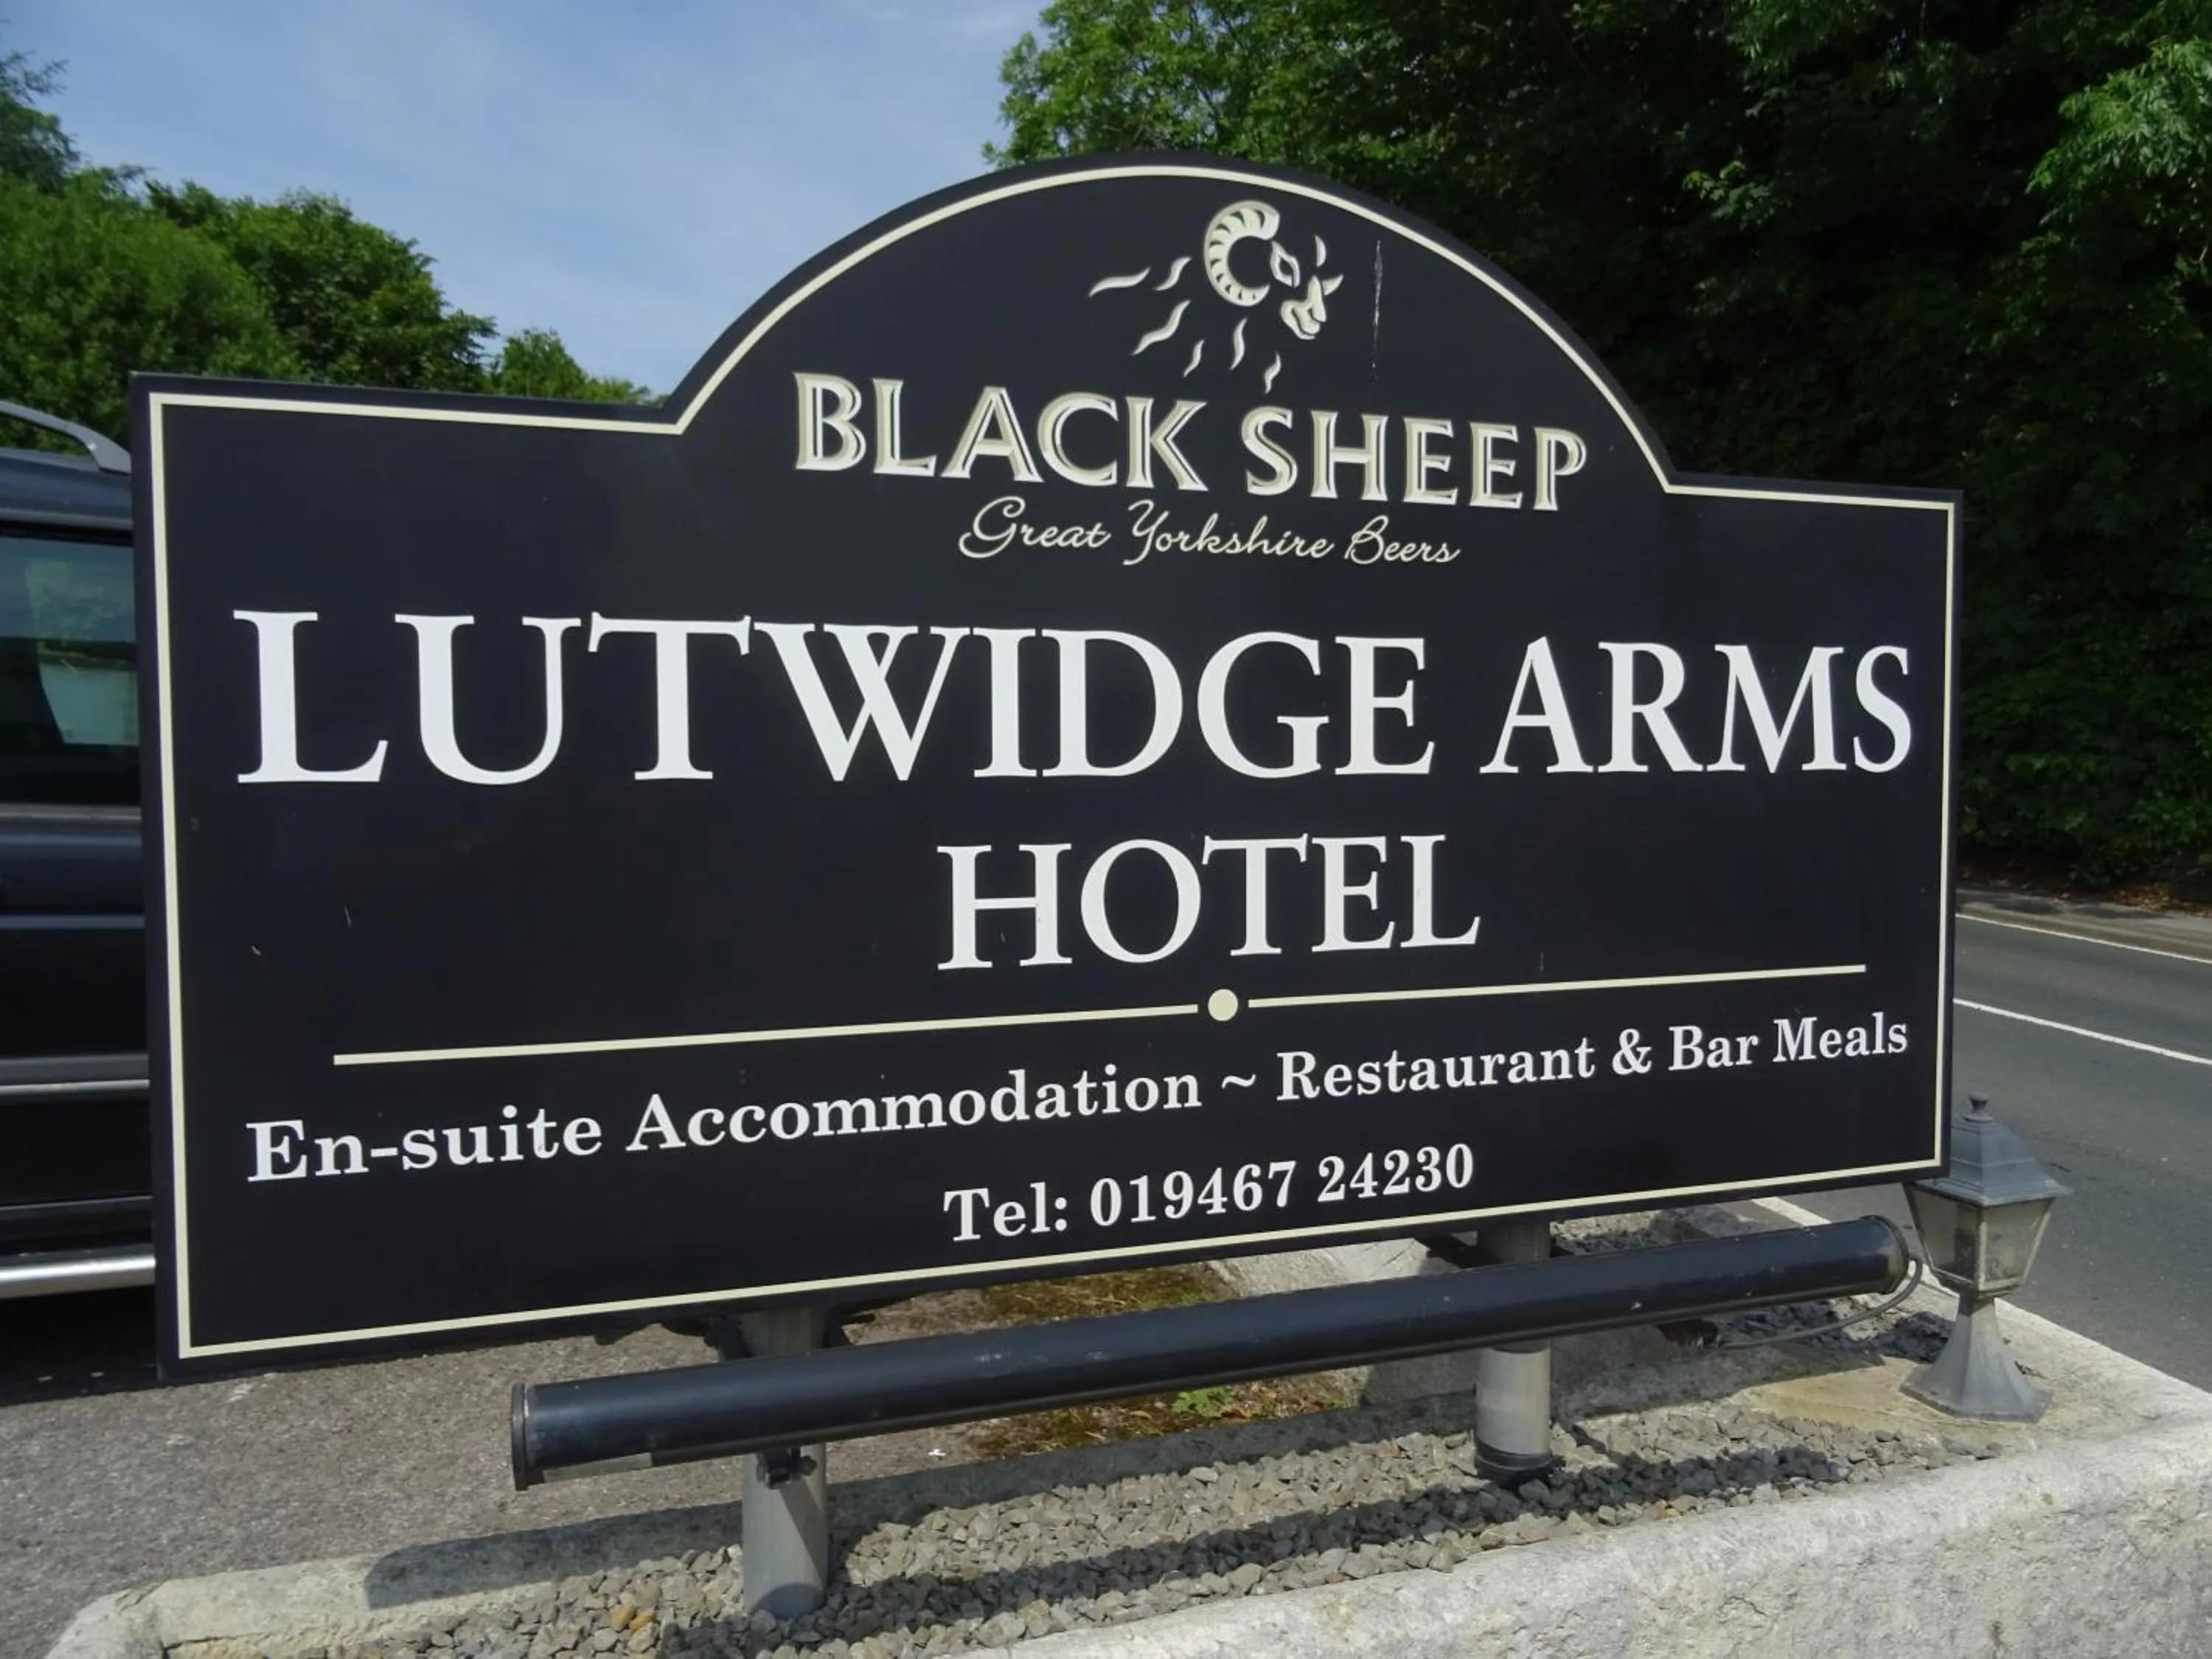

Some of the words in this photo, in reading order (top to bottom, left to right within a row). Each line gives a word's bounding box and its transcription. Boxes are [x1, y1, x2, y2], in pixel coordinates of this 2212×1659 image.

[794, 372, 1208, 491] BLACK
[1242, 406, 1586, 511] SHEEP
[958, 495, 1112, 559] Great
[1123, 499, 1335, 565] Yorkshire
[1344, 515, 1461, 565] Beers
[233, 610, 1436, 785] LUTWIDGE
[1479, 636, 1912, 774] ARMS
[937, 834, 1481, 970] HOTEL
[246, 1105, 602, 1182] En-suite
[625, 1064, 1203, 1152] Accommodation
[1276, 1037, 1596, 1101] Restaurant
[1612, 1028, 1652, 1076] &
[1669, 1025, 1759, 1071] Bar
[1772, 1011, 1907, 1062] Meals
[943, 1181, 1068, 1242] Tel:
[1090, 1160, 1297, 1227] 019467
[1317, 1143, 1474, 1203] 24230
